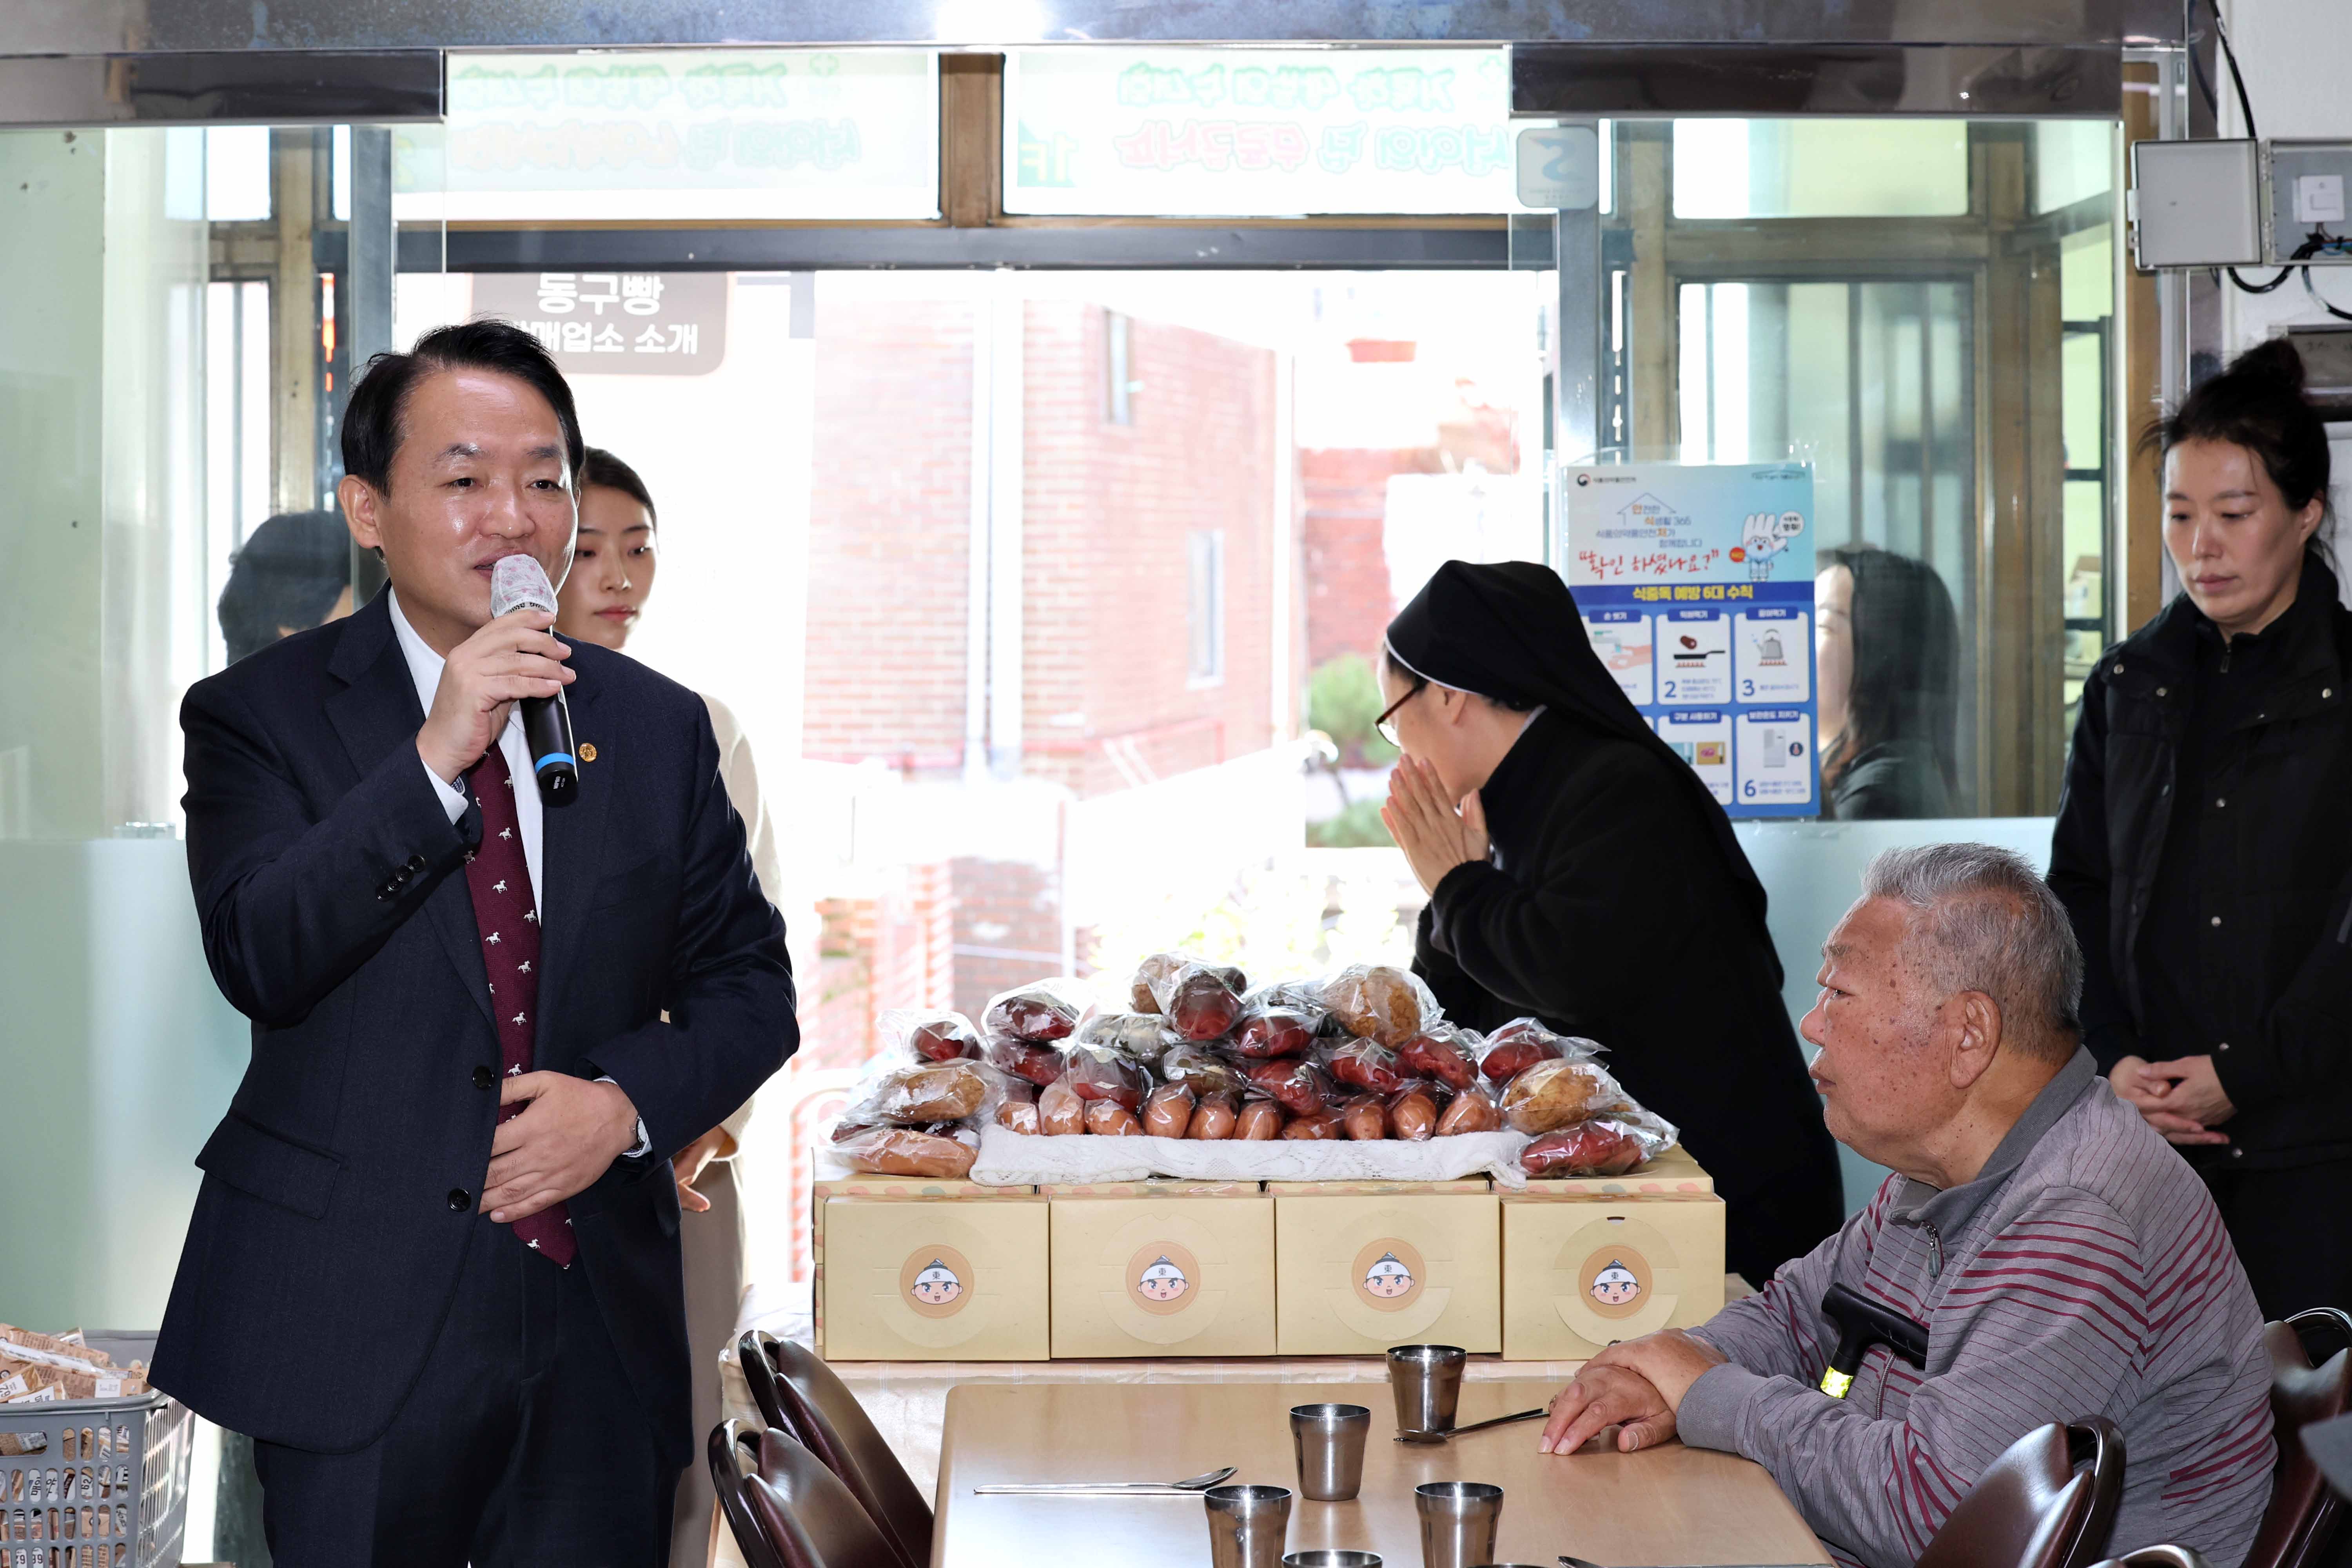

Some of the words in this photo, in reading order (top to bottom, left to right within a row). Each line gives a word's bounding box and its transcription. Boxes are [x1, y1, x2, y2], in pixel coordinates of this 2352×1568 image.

[537, 272, 664, 315] 동구빵
[514, 321, 624, 354] 매업소
[634, 323, 698, 354] 소개
[1633, 586, 1671, 601] 식중독
[1674, 586, 1701, 600] 예방
[1703, 585, 1725, 599] 6대
[1727, 584, 1753, 599] 수칙
[1665, 681, 1677, 698] 2
[1742, 679, 1755, 696] 3
[1745, 779, 1756, 797] 6
